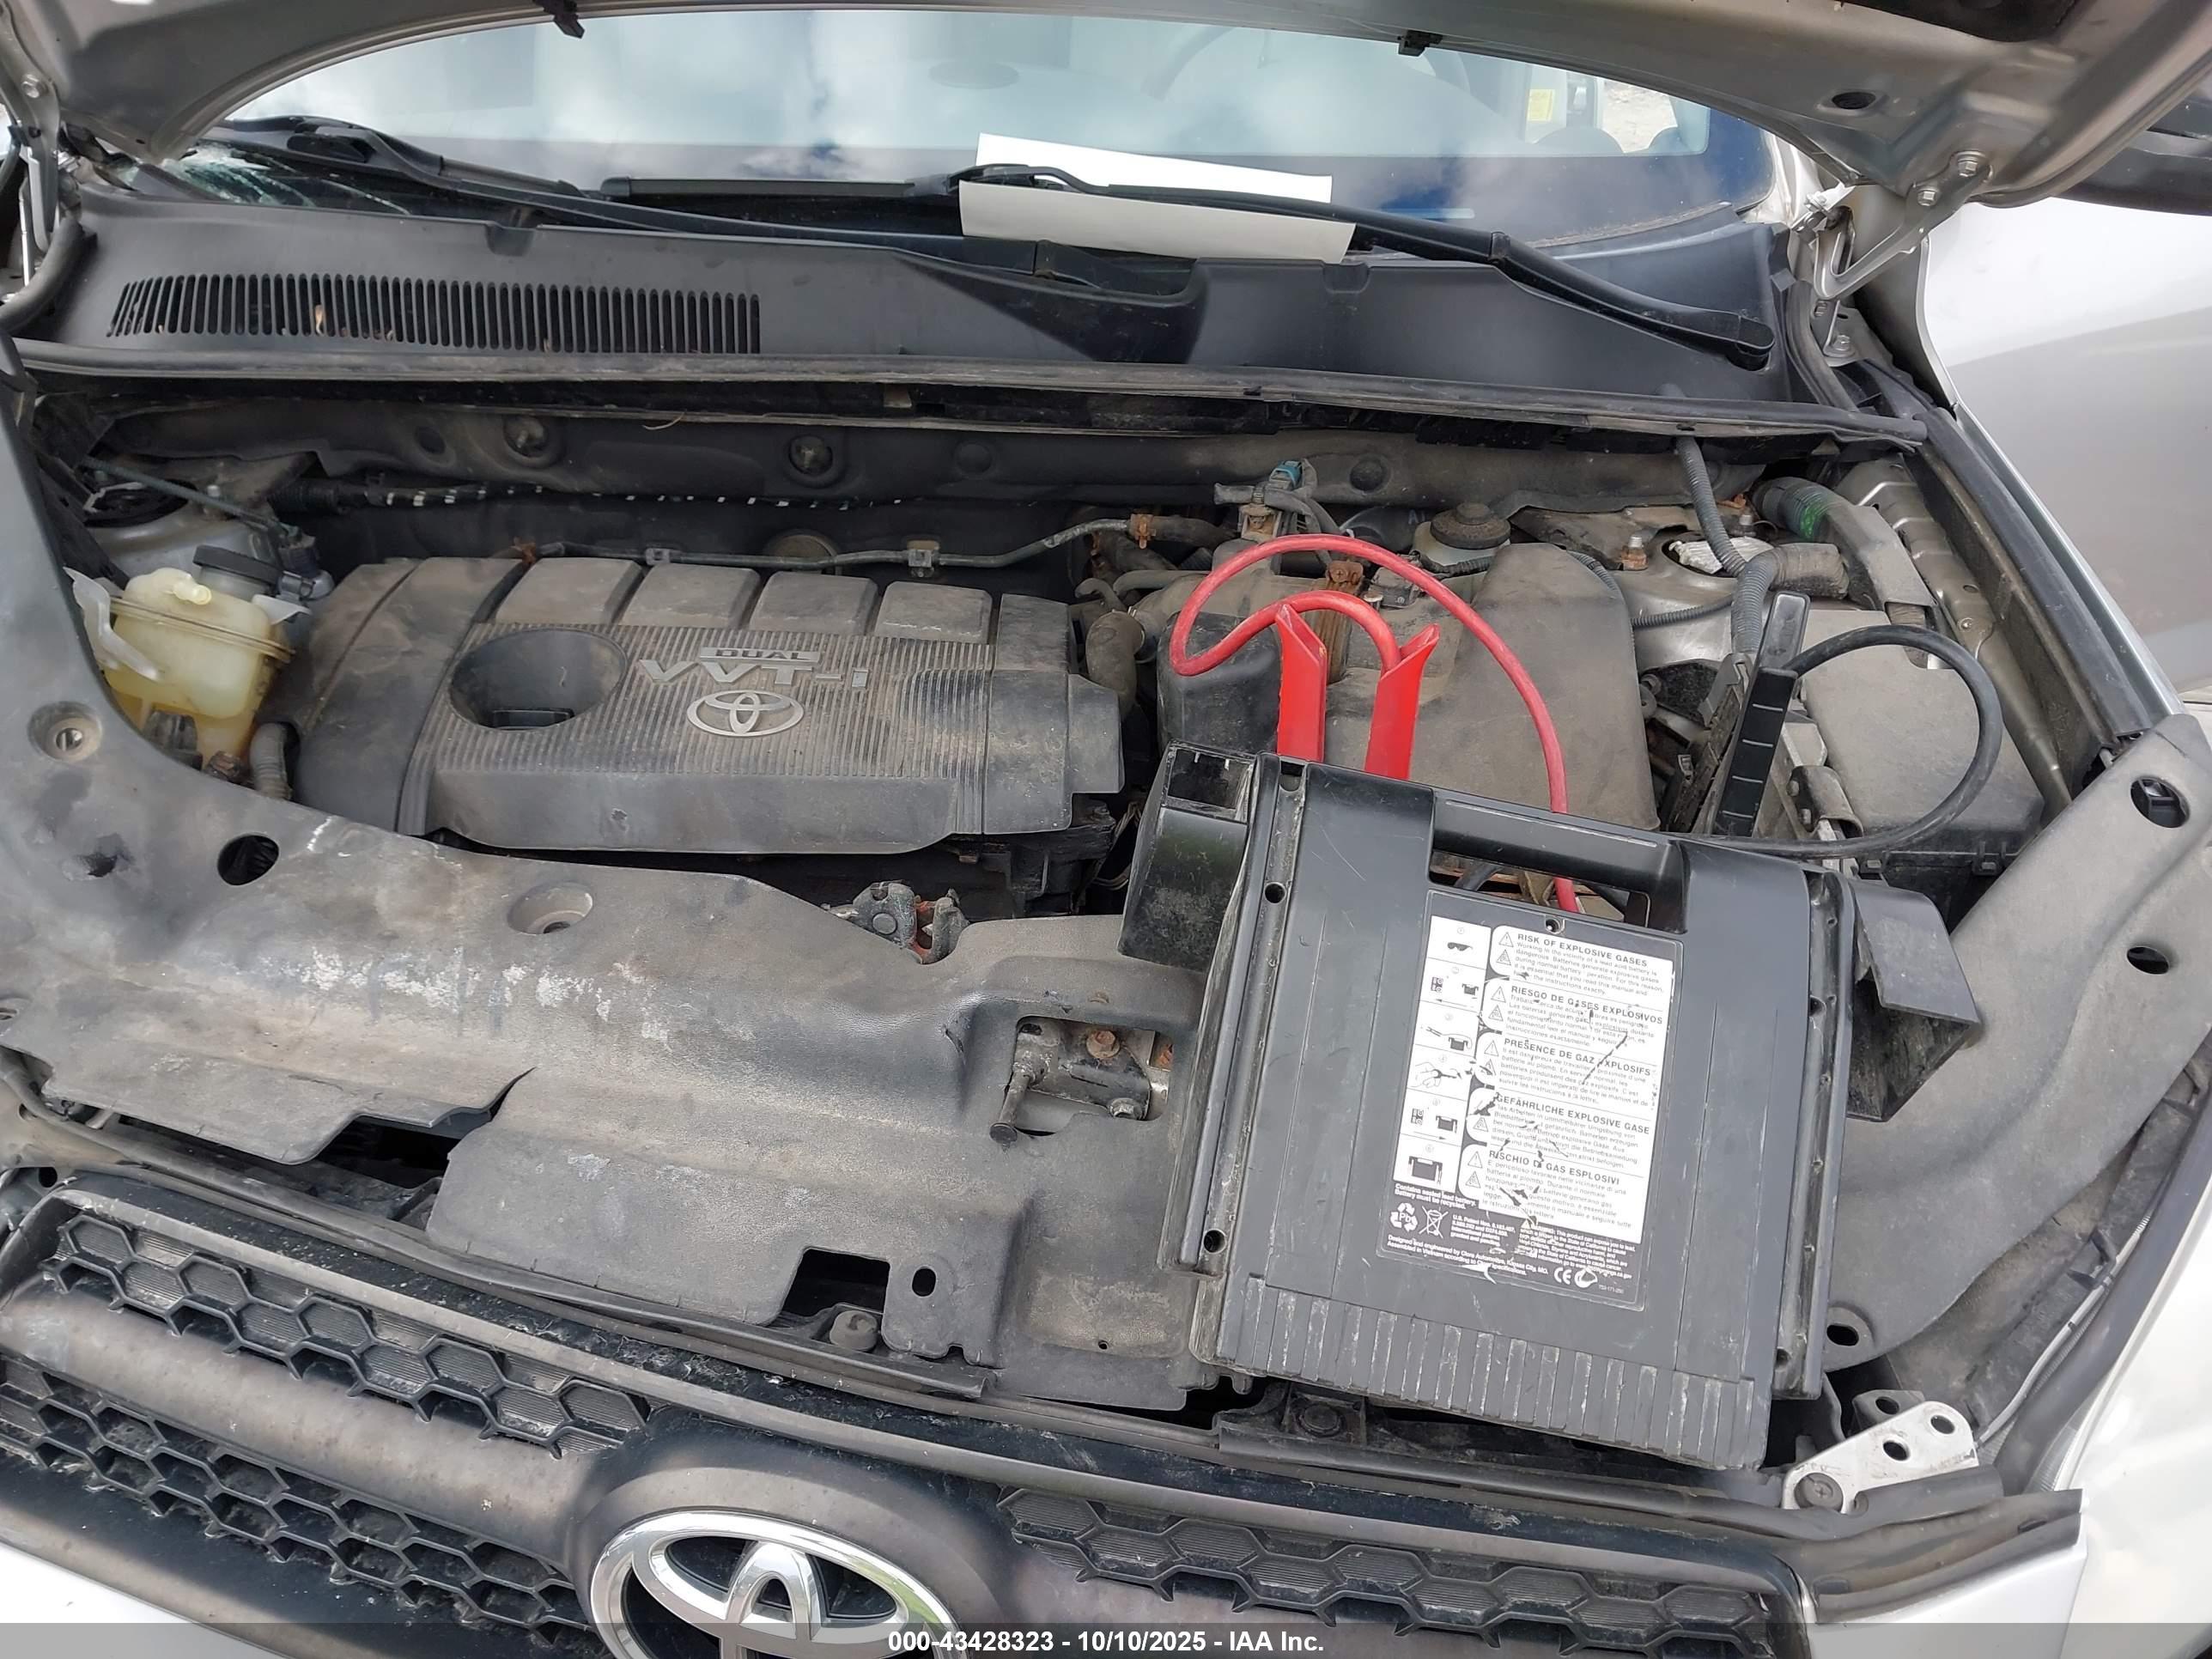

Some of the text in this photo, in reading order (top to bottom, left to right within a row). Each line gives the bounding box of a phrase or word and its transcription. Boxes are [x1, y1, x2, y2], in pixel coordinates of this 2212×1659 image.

[715, 648, 805, 661] DUAL
[1517, 933, 1647, 966] RISK OF EXPLOSIVE GASES
[1510, 985, 1547, 1000] RIESGO
[1551, 994, 1564, 1003] DE
[1601, 1005, 1662, 1024] EXPLOSIVOS
[1559, 1049, 1572, 1059] DE
[1575, 1053, 1595, 1064] GAZ
[1598, 1058, 1650, 1076] XPLOSIFS
[1567, 1108, 1621, 1127] EXPLOSIVE
[1624, 1120, 1650, 1134] GASE
[1533, 1159, 1541, 1168] D
[1545, 1162, 1566, 1173] GAS
[1569, 1167, 1619, 1185] ESPLOSIVI
[1399, 1212, 1411, 1223] Pb
[1553, 1266, 1571, 1285] CE
